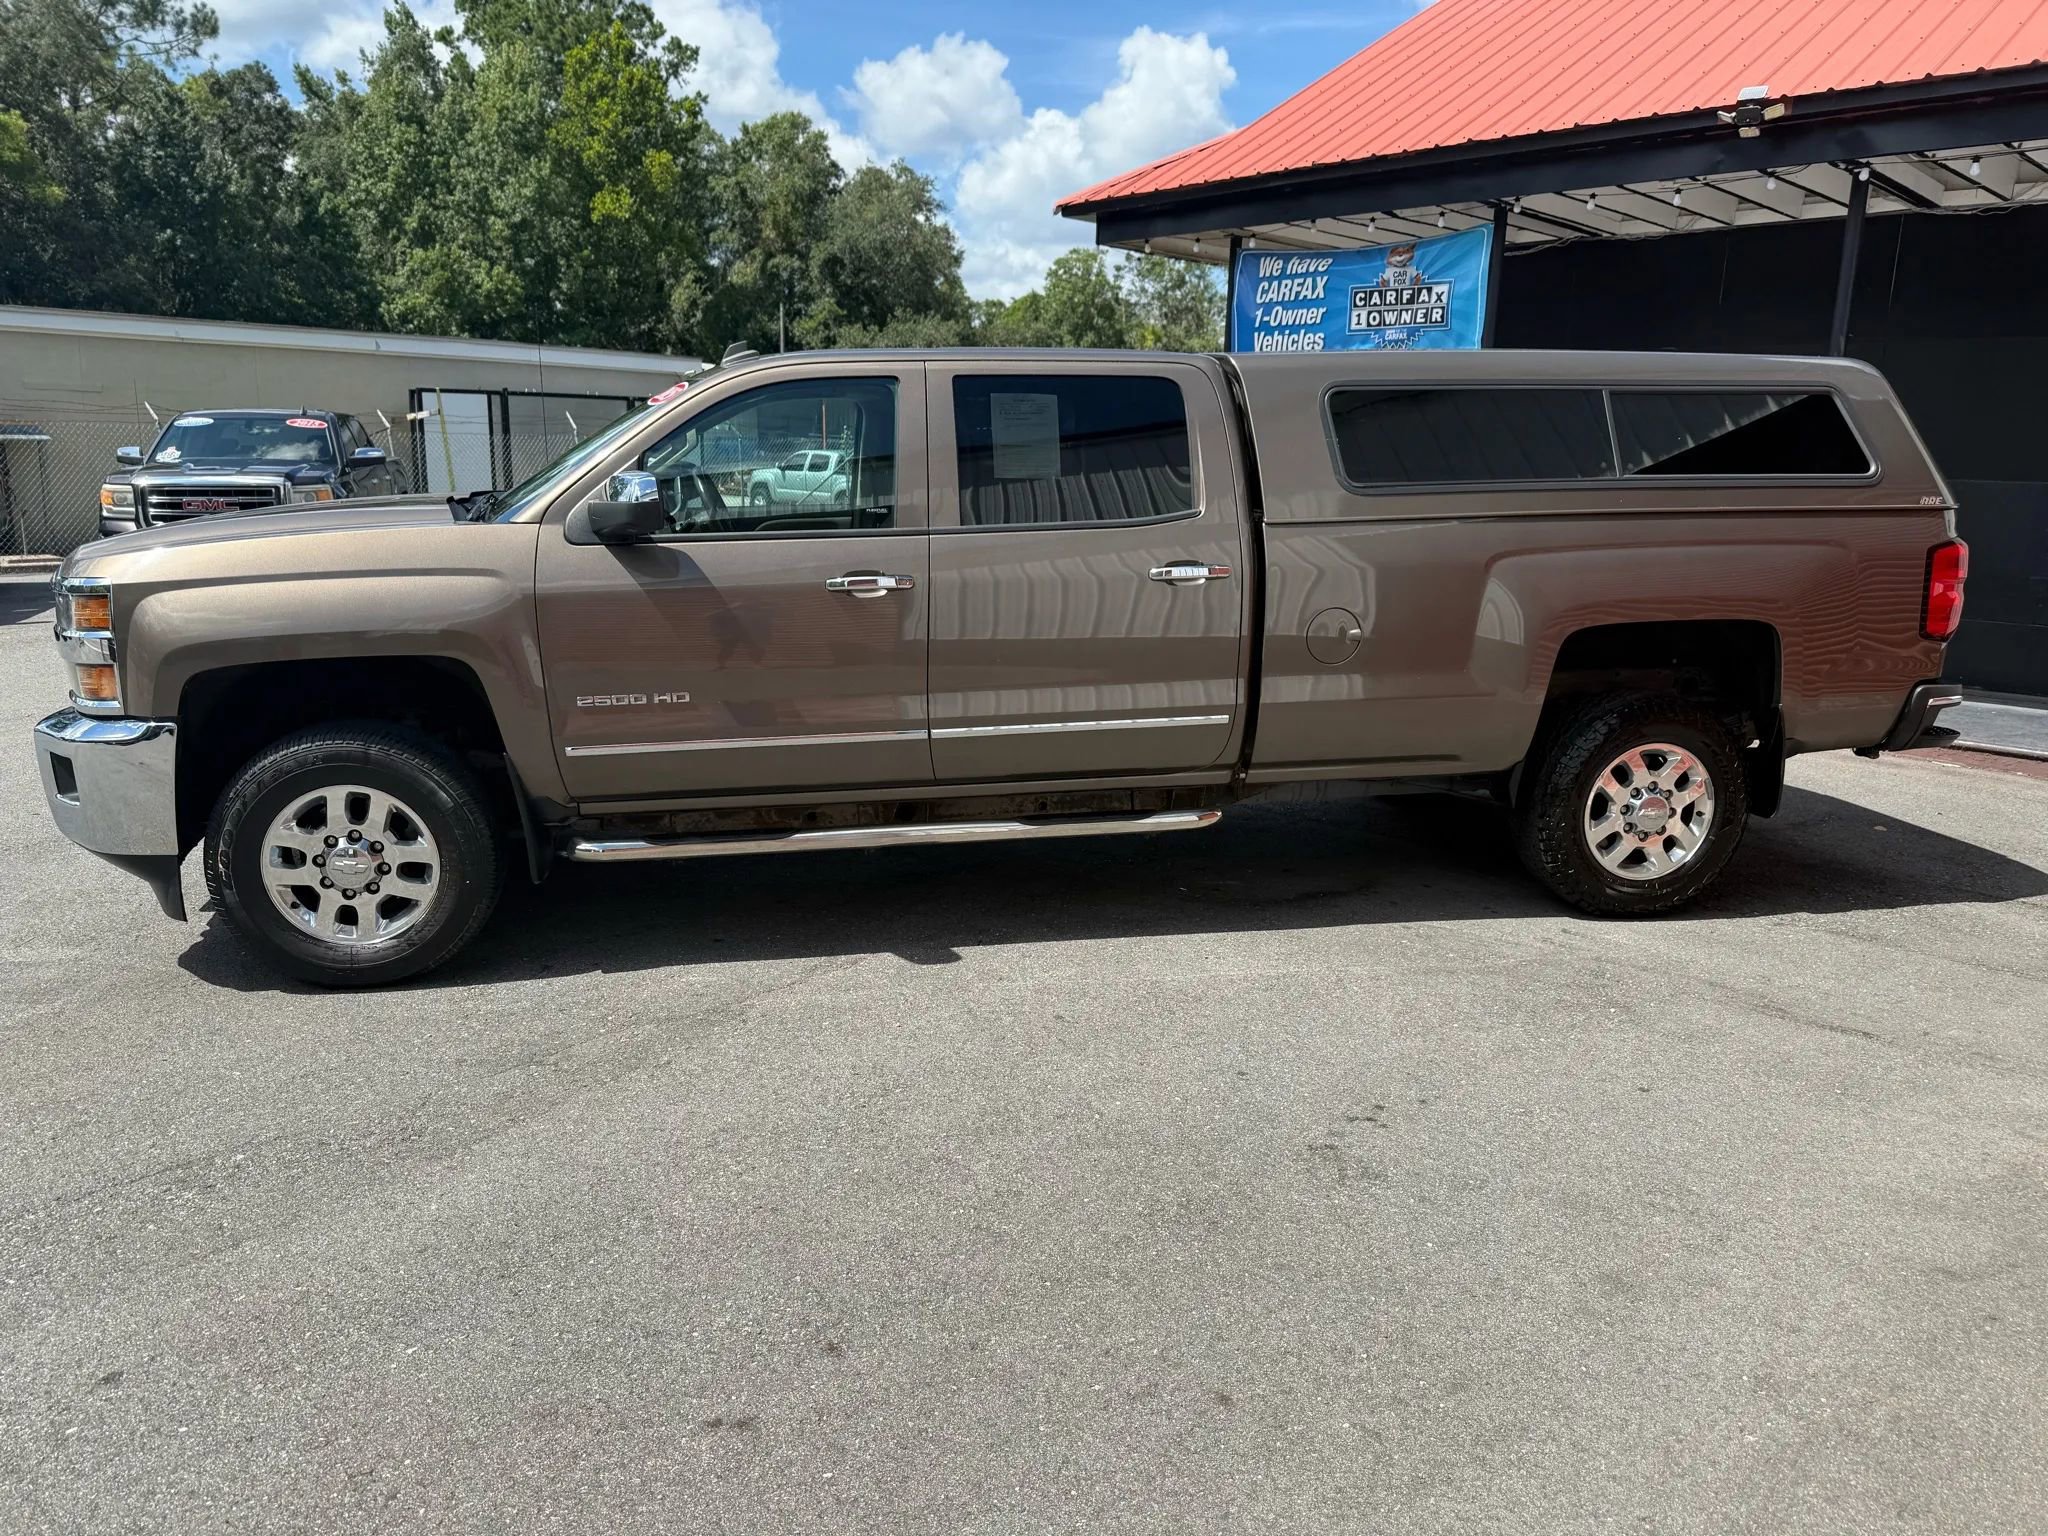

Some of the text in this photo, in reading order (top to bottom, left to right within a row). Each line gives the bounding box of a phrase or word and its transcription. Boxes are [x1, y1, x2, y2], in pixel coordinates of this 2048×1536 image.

[1259, 256, 1334, 278] We have
[1392, 270, 1408, 279] CAR
[1256, 275, 1329, 304] CARFAX
[1393, 278, 1407, 286] FOX
[1355, 288, 1446, 307] CARFAX
[1254, 306, 1328, 328] 1-Owner
[1254, 329, 1326, 352] Vehicles
[182, 497, 240, 512] GMC
[576, 692, 690, 707] 2500 HD
